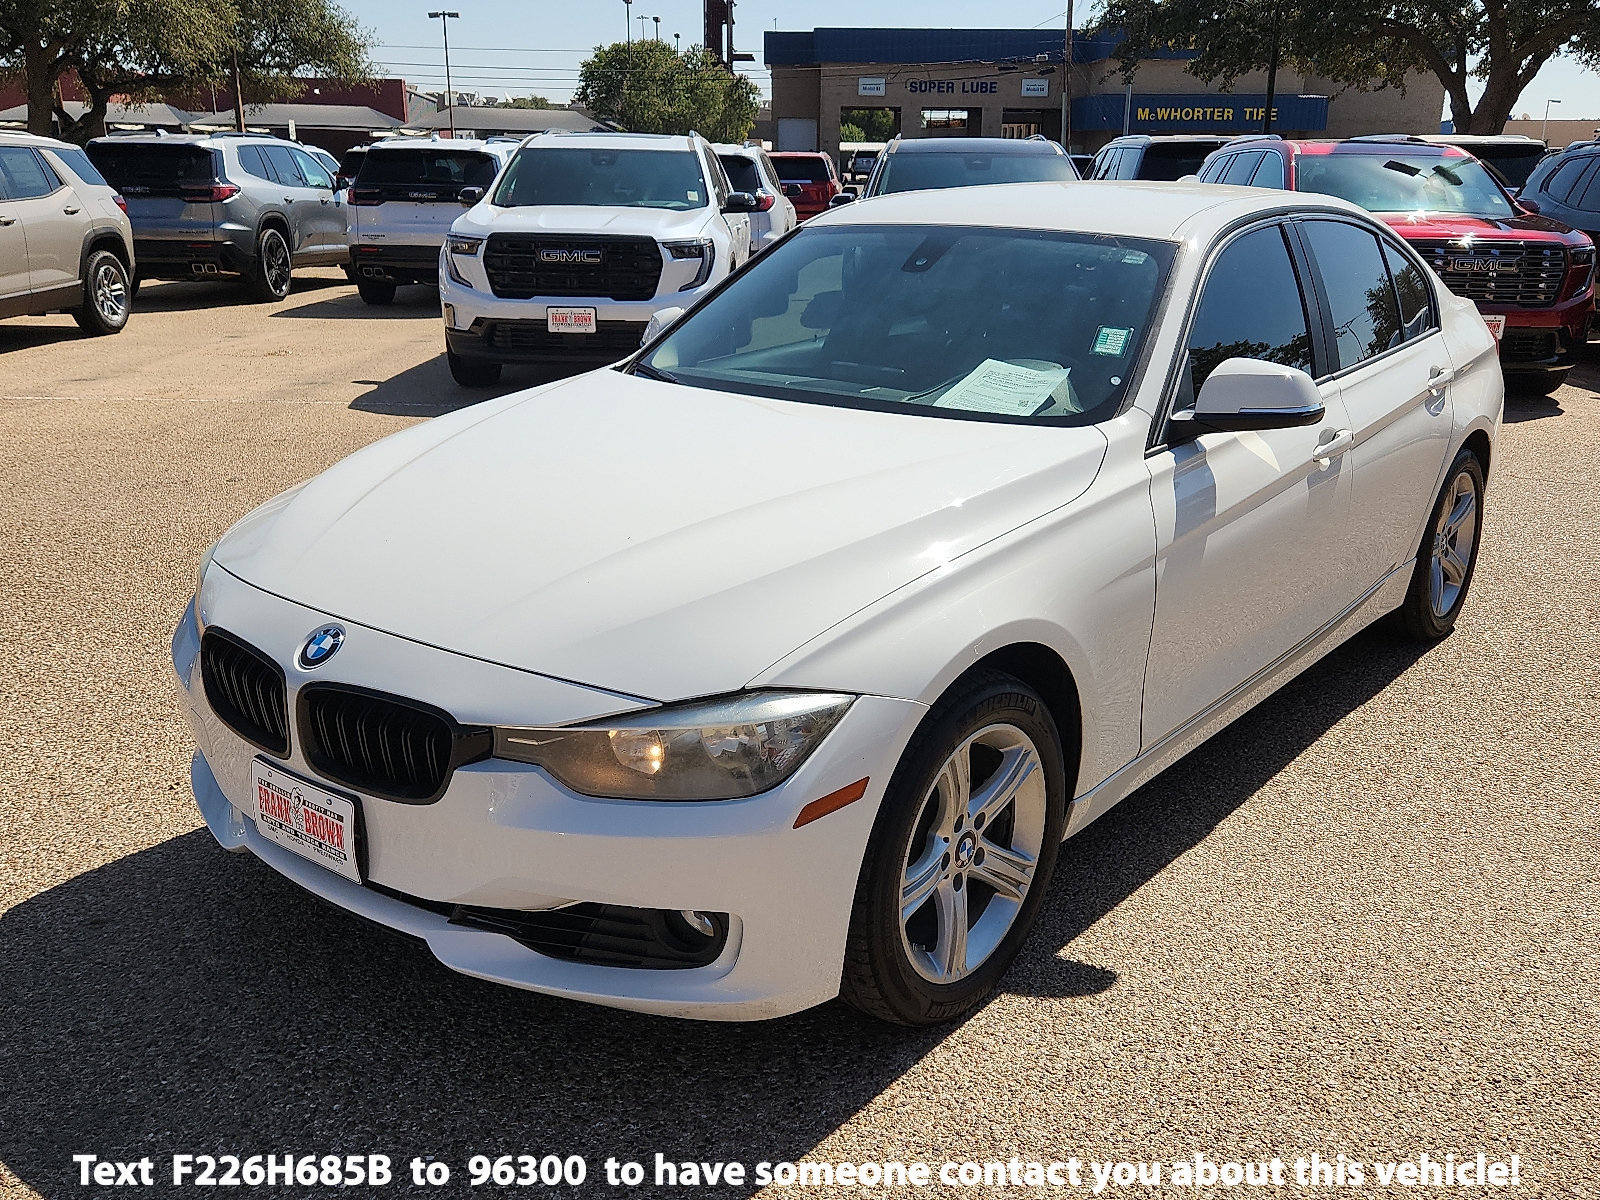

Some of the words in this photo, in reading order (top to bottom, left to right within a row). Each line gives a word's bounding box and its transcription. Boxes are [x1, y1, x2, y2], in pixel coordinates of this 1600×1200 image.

[909, 81, 955, 93] SUPER
[961, 82, 998, 94] LUBE
[1137, 107, 1234, 121] McWHORTER
[541, 249, 600, 262] GMC
[1455, 258, 1517, 271] GMC
[258, 785, 293, 825] FRANK
[303, 807, 345, 850] BROWN
